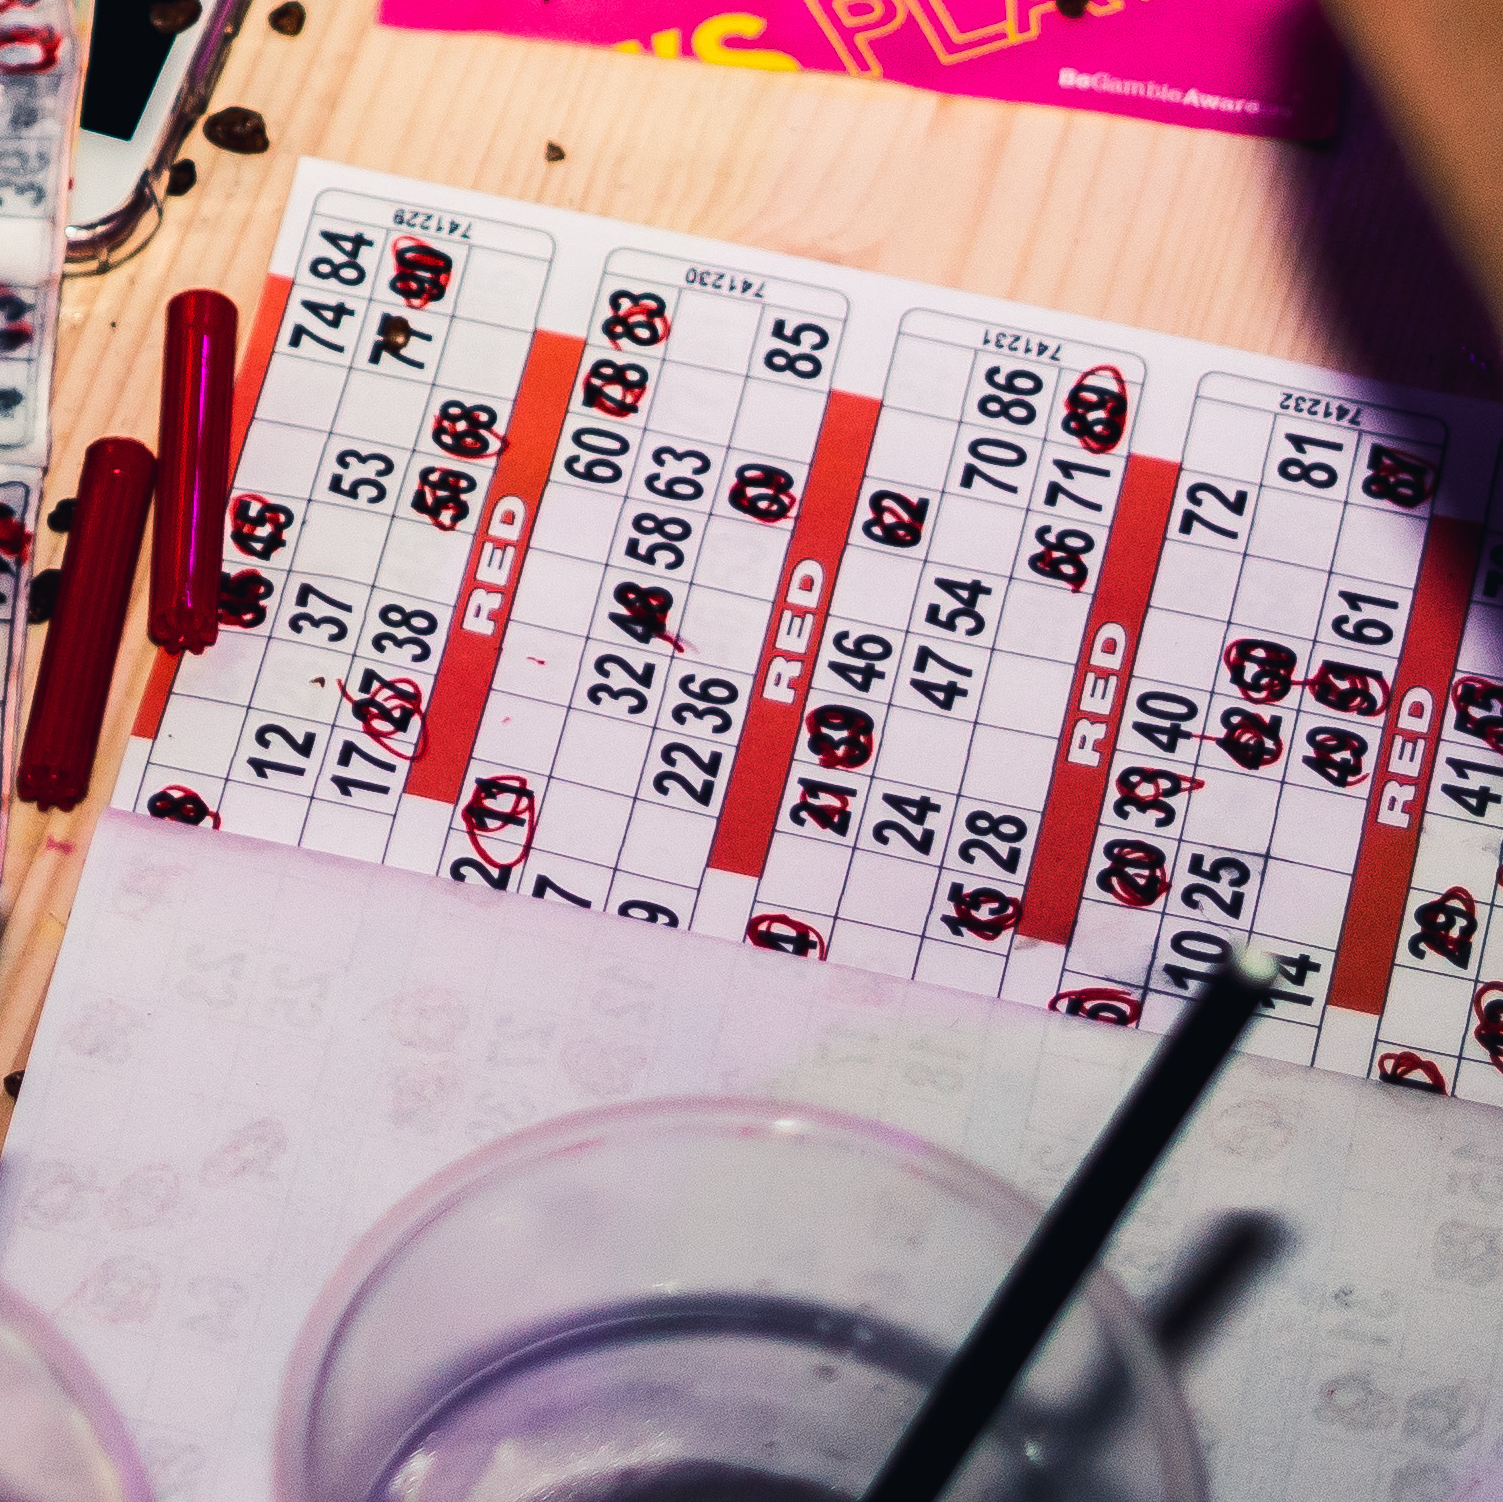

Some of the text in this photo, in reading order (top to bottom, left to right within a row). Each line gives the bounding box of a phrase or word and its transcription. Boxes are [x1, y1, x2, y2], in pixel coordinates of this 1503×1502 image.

[289, 227, 375, 358] 74 84
[563, 426, 631, 487] 60
[643, 445, 713, 503] 63
[460, 495, 528, 637] RED
[625, 512, 694, 571] 58
[652, 319, 831, 808] 22 36 85
[871, 365, 1046, 858] 24 47 54 70 86
[246, 448, 395, 782] 12 37 53
[587, 652, 655, 716] 32
[761, 558, 828, 703] RED
[827, 629, 895, 694] 46
[958, 457, 1113, 875] 28 71
[1131, 481, 1250, 758] 40 72
[1179, 431, 1345, 921] 25 81
[1331, 590, 1401, 647] 61
[330, 603, 439, 802] 17 38
[1066, 622, 1127, 769] RED
[1377, 685, 1437, 829] RED
